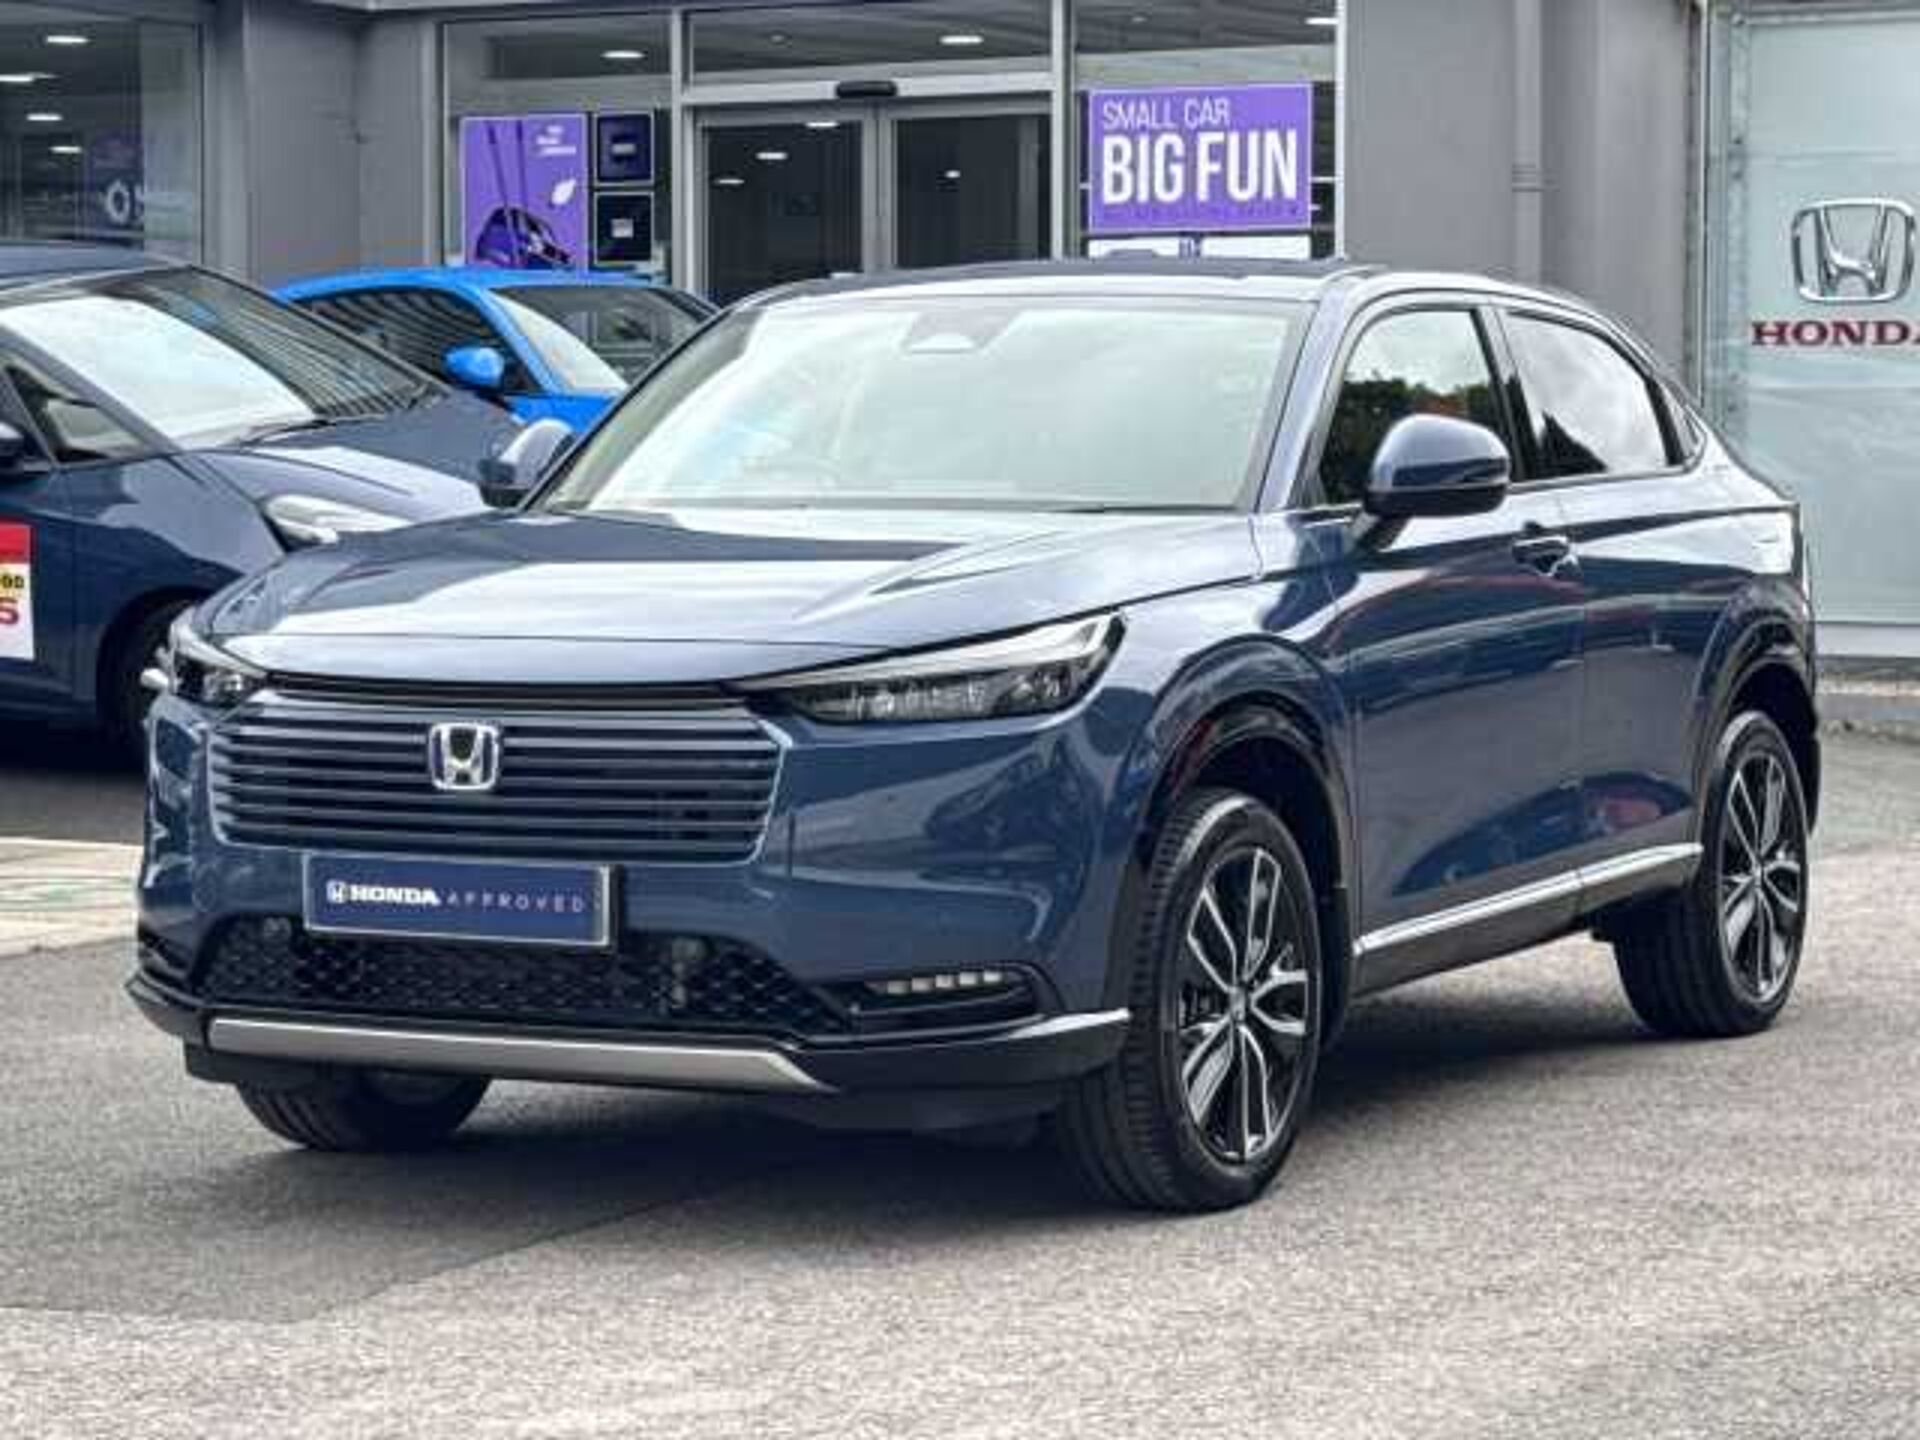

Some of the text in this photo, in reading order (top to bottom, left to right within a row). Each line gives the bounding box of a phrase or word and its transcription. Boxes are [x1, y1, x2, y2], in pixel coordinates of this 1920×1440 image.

[1103, 97, 1230, 130] SMALL CAR
[1103, 129, 1297, 205] BIG FUN
[1752, 320, 1920, 346] HOND
[350, 885, 586, 913] HONDA APPROVED
